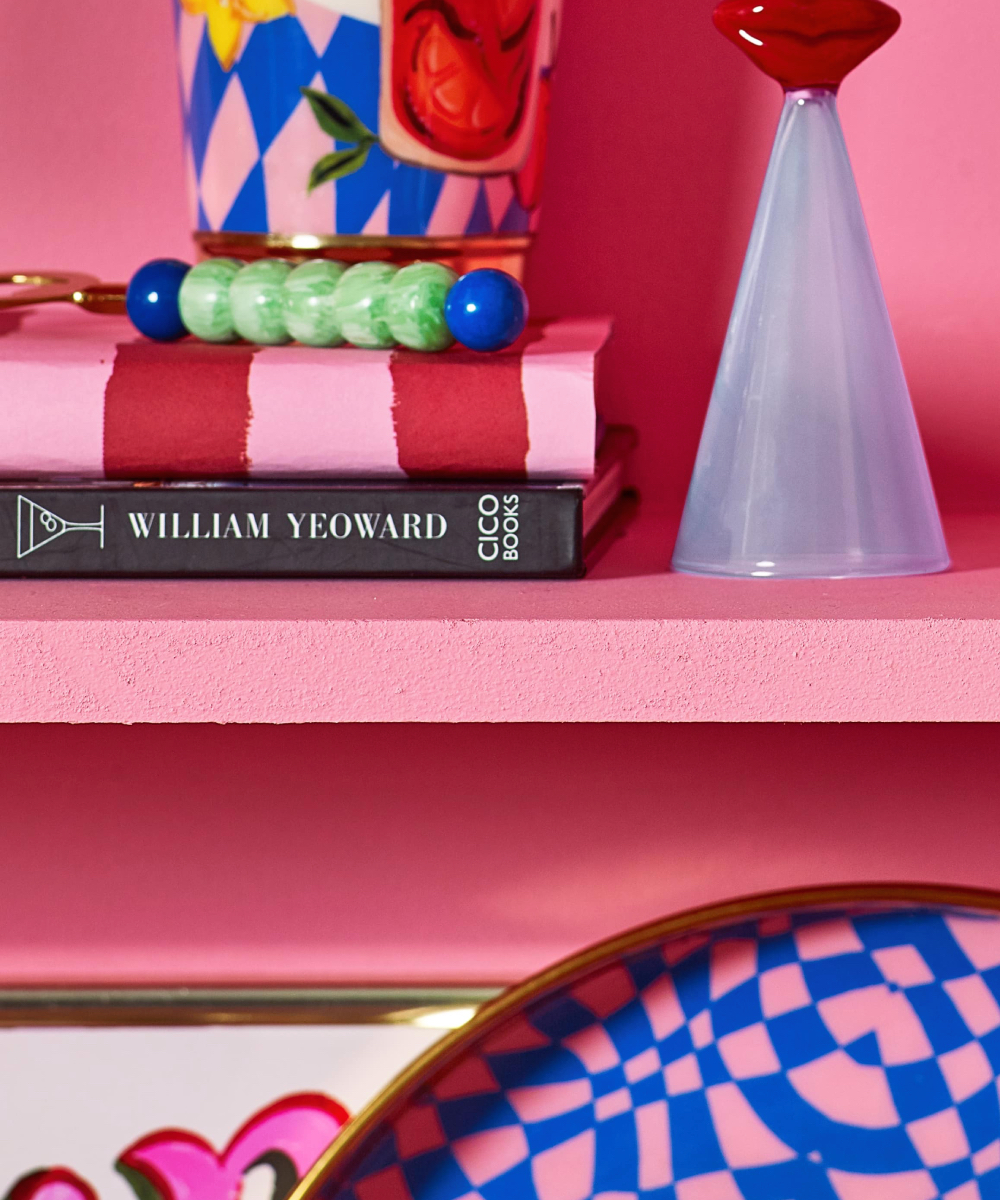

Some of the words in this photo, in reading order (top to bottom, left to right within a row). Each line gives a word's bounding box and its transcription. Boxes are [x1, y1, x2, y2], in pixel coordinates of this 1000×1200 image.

[127, 512, 271, 540] WILLIAM
[286, 512, 448, 540] YEOWARD
[477, 493, 500, 562] CICO
[502, 493, 520, 561] BOOKS
